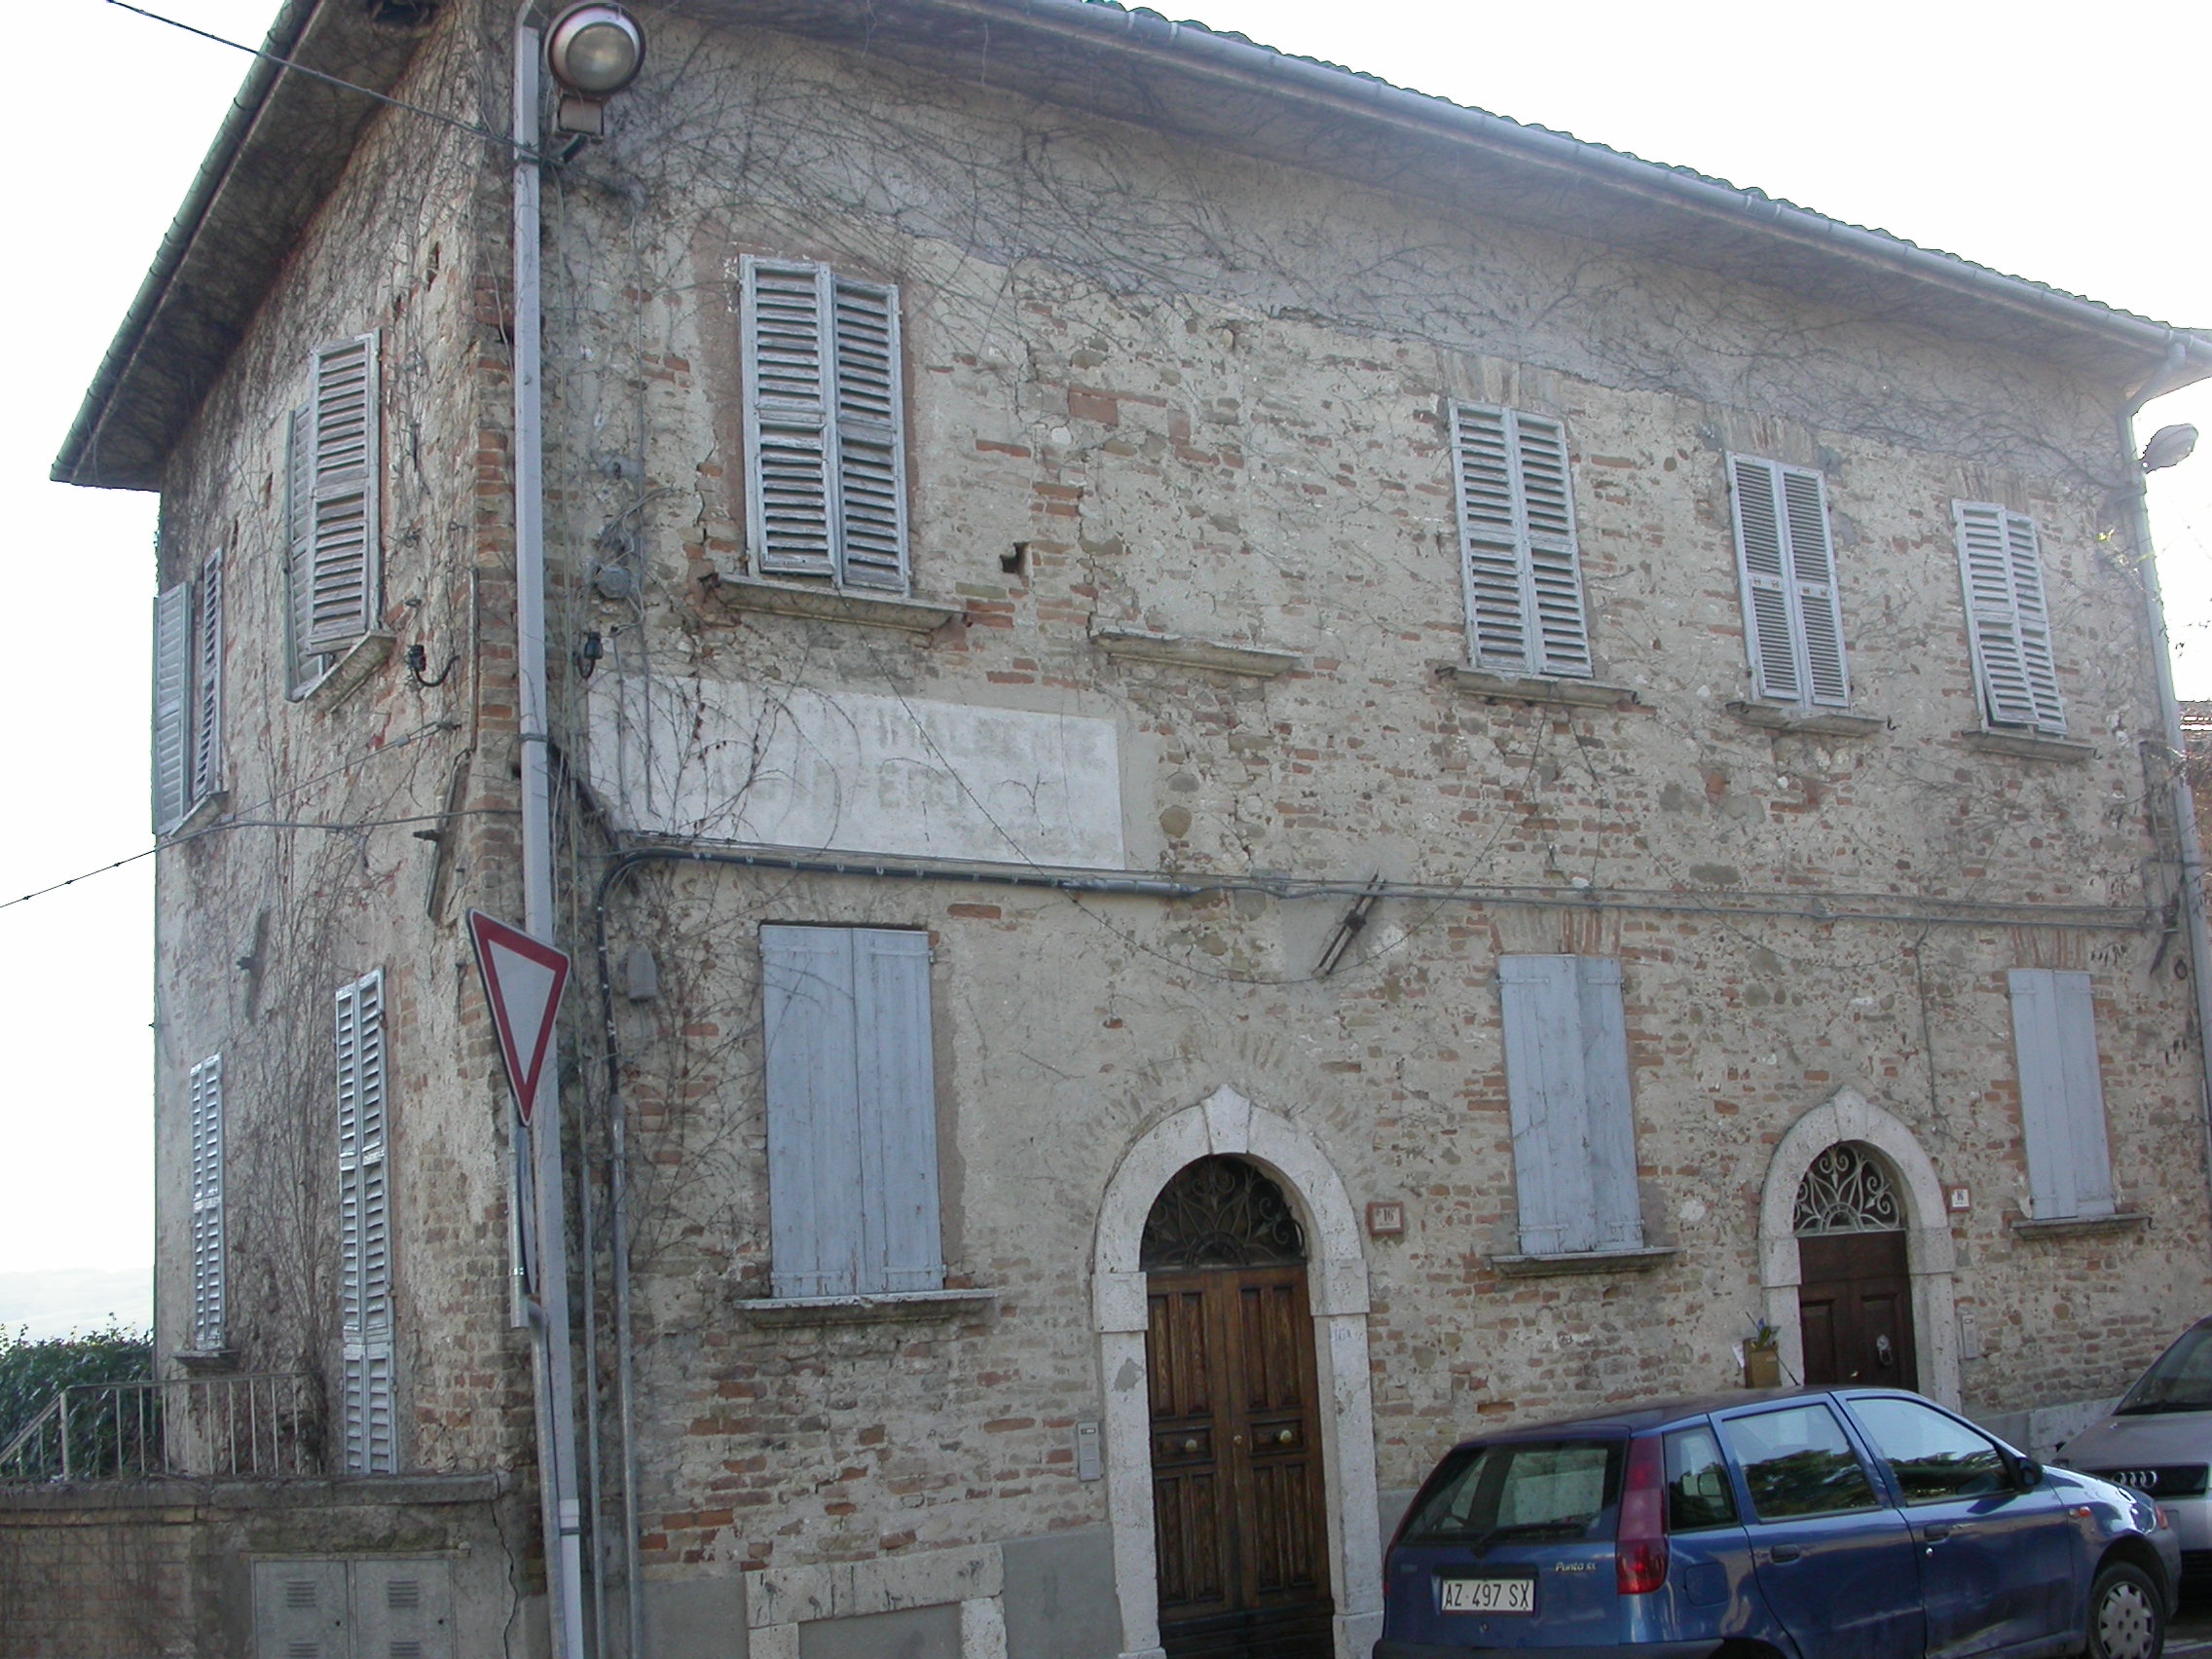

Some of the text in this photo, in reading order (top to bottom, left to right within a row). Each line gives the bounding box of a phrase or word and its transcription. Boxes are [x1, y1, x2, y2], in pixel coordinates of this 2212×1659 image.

[1555, 1561, 1584, 1572] Punto
[1445, 1582, 1530, 1607] AZ 497 SX
